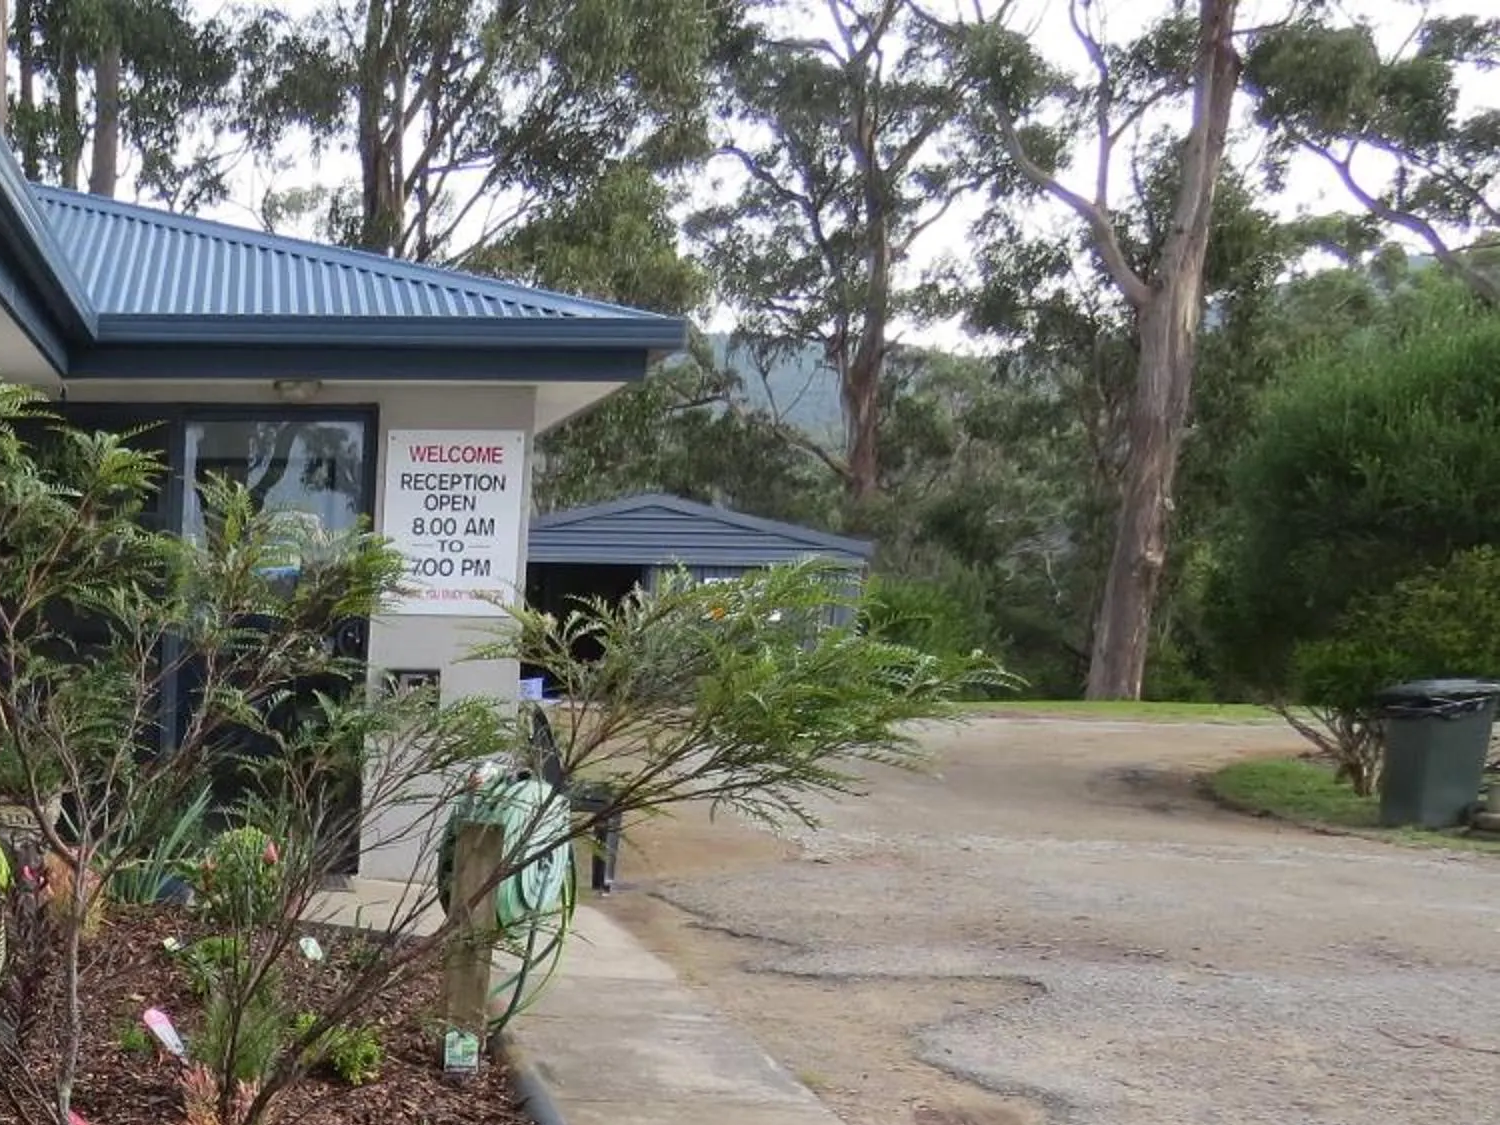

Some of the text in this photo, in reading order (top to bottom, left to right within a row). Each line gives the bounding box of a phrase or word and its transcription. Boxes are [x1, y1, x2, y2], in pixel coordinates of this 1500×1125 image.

[409, 445, 504, 463] WELCOME
[401, 473, 507, 491] RECEPTION
[424, 494, 477, 511] OPEN
[412, 517, 495, 536] 8.00 AM
[438, 539, 465, 553] TO
[461, 559, 491, 577] PM
